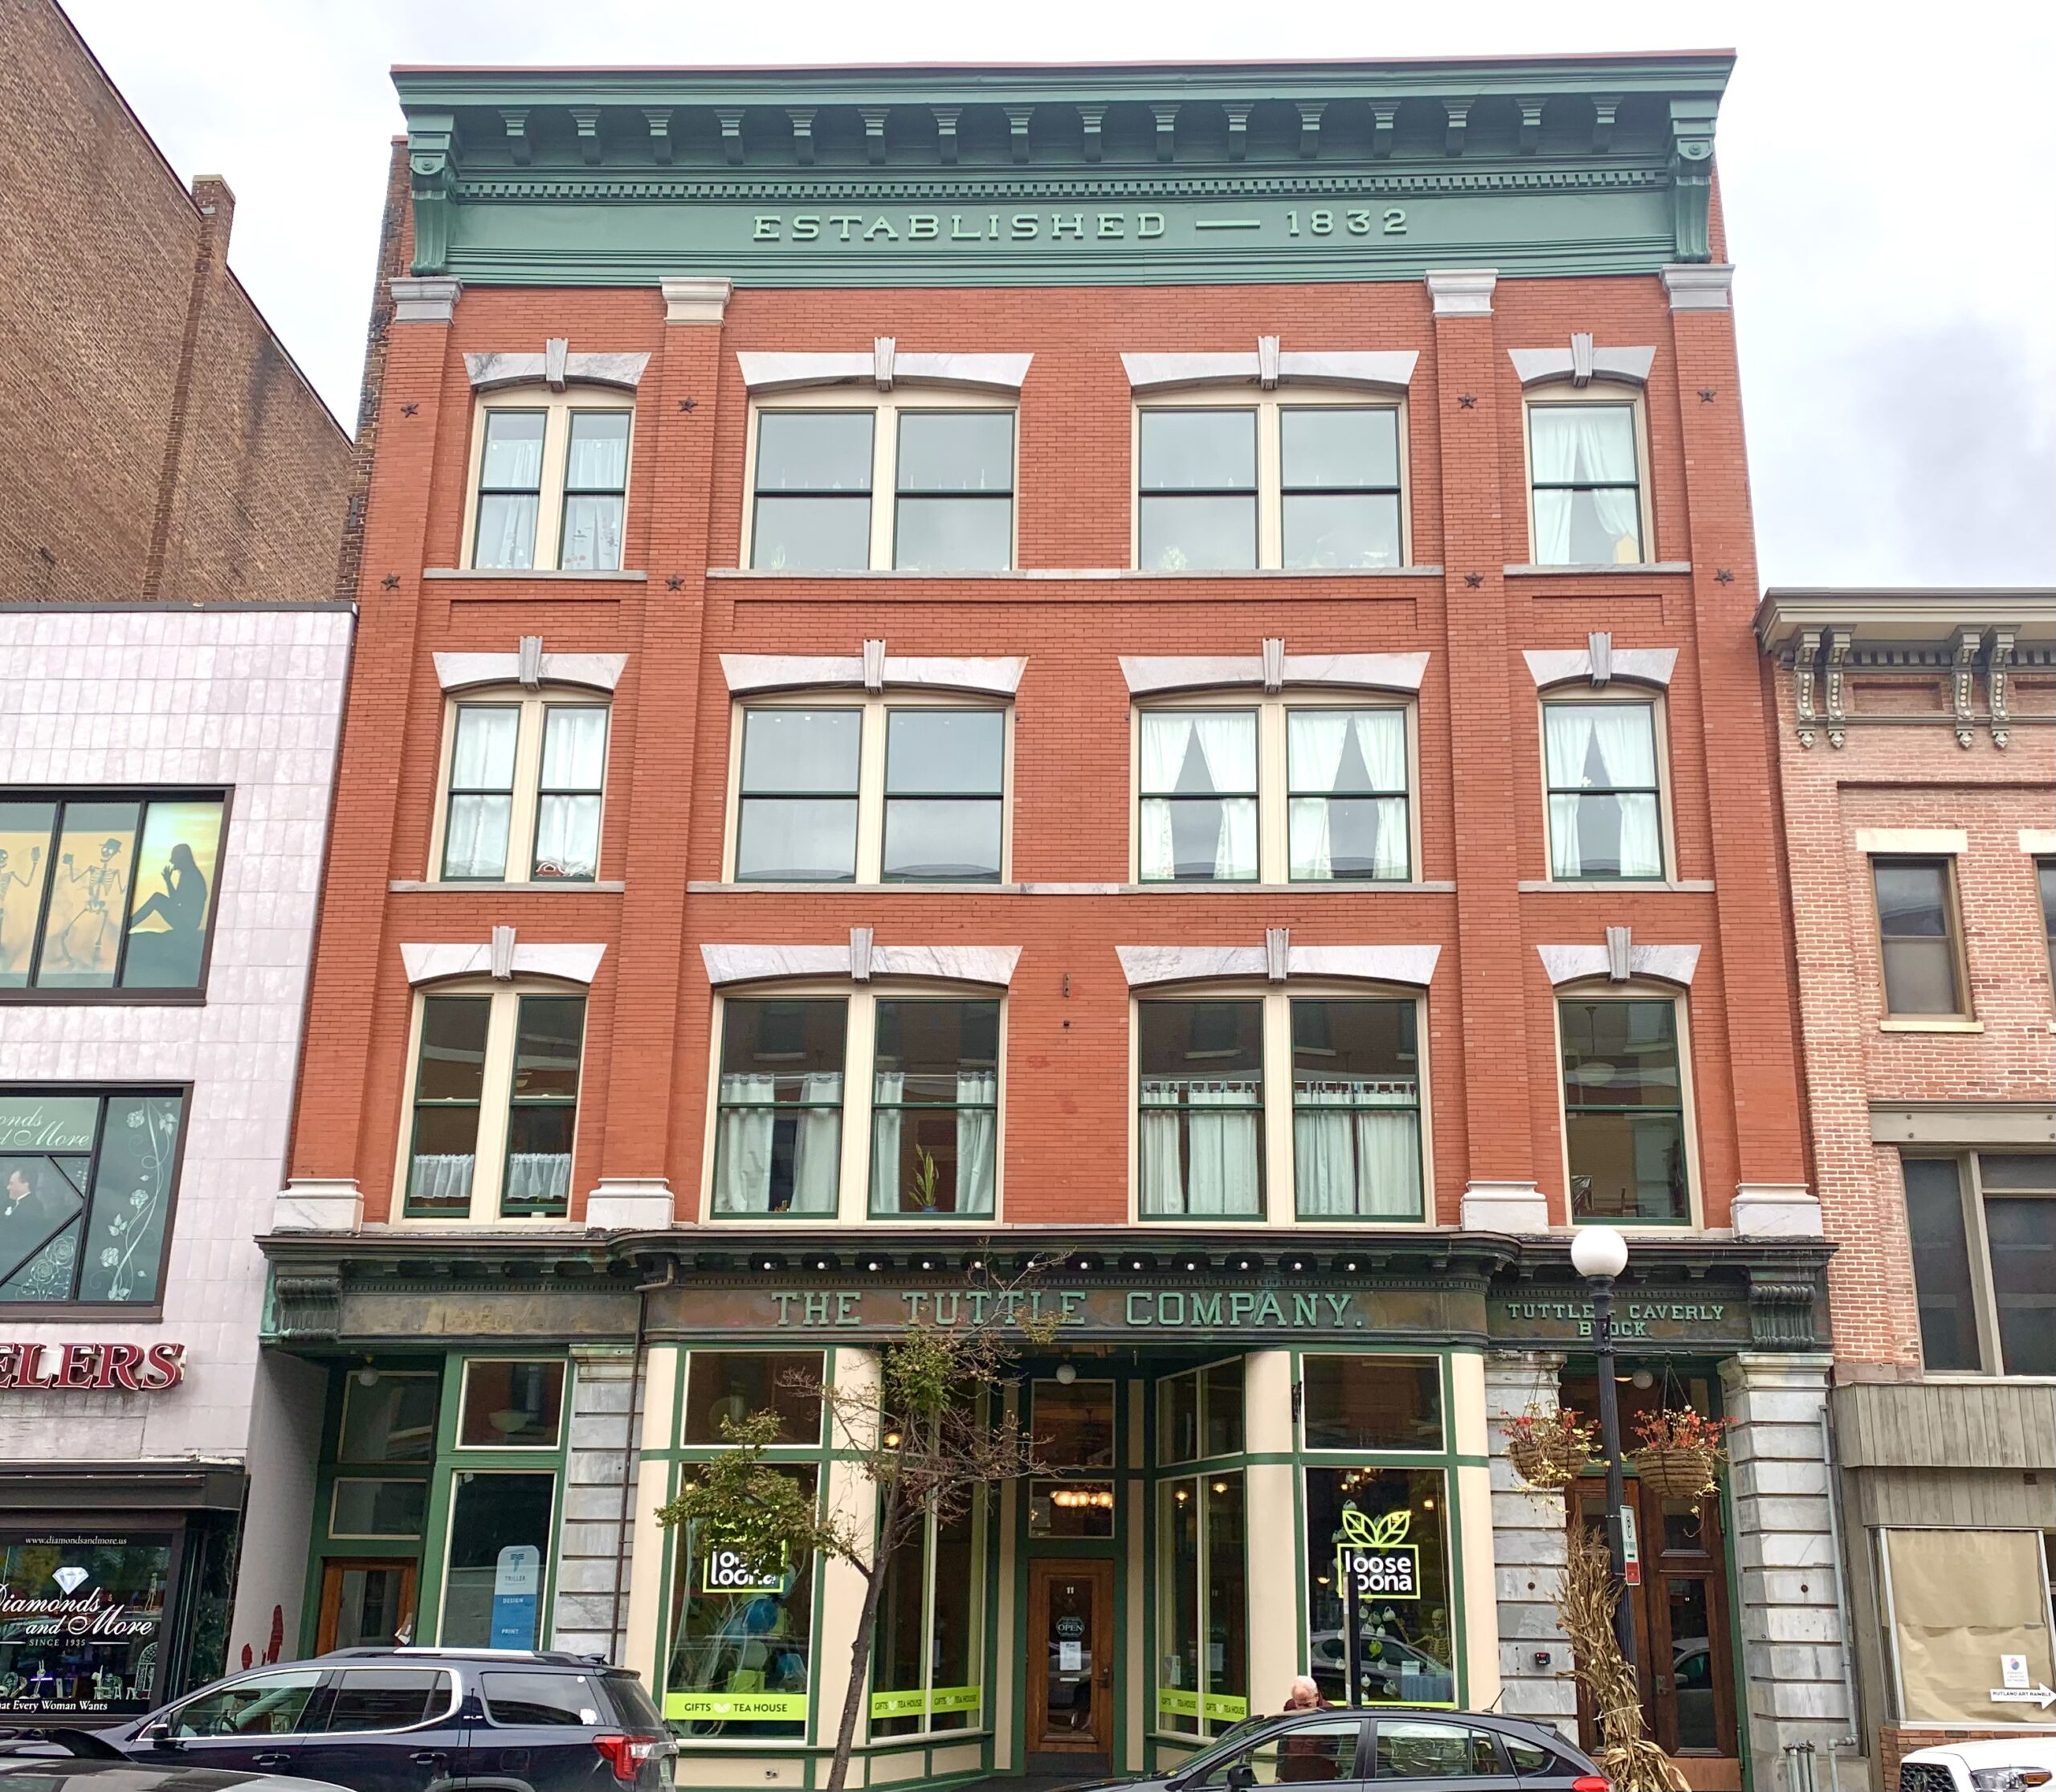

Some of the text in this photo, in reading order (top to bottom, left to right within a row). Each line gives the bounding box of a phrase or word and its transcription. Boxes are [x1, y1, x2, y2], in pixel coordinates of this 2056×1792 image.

[753, 212, 1165, 241] ESTABLISHED
[1287, 209, 1407, 236] 1832
[14, 1121, 89, 1146] More
[771, 1292, 862, 1325] THE
[901, 1292, 1086, 1325] TUTTLE
[1507, 1304, 1596, 1320] TUTTLE
[1629, 1304, 1724, 1321] CAVERLY
[25, 1535, 128, 1545] www.diamondsandmore.us
[1344, 1550, 1412, 1573] loose
[26, 1604, 153, 1635] and More
[29, 1639, 87, 1647] SINCE 1935
[13, 1700, 39, 1713] Every
[42, 1700, 76, 1710] Woman
[80, 1700, 108, 1711] Wants
[684, 1703, 788, 1712] GIFTS TEA HOUSE
